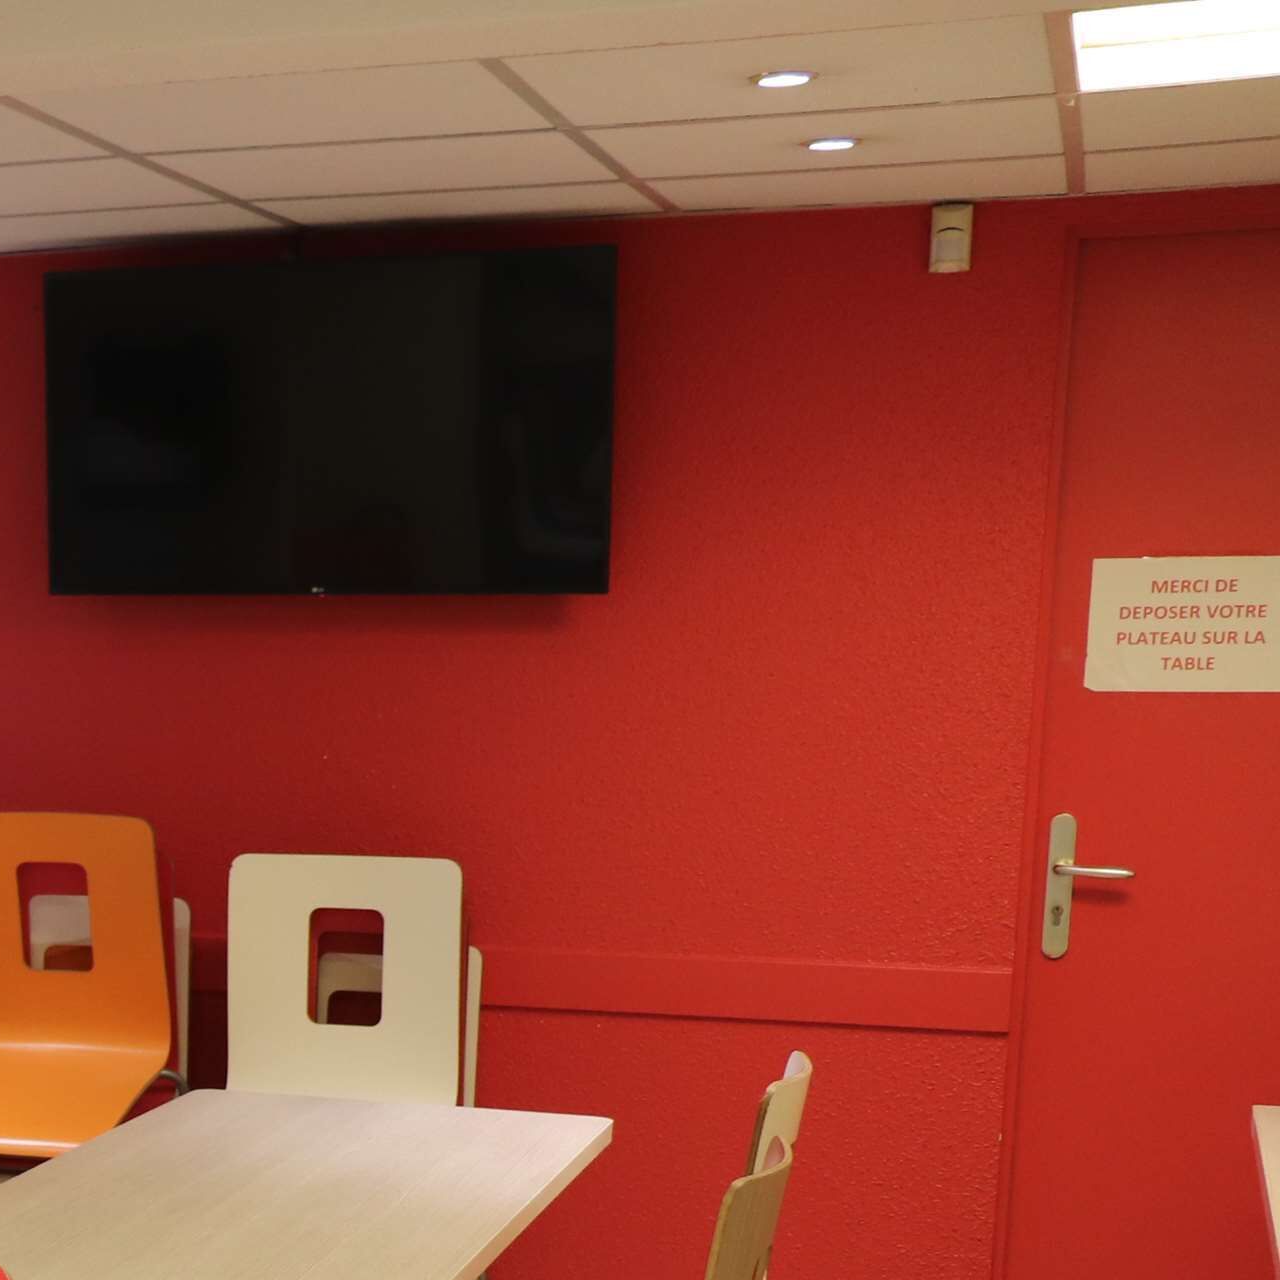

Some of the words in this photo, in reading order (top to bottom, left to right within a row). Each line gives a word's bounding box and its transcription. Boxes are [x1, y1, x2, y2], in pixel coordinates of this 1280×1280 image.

[1151, 580, 1209, 594] MERCI
[1215, 579, 1239, 593] DE
[1119, 605, 1201, 620] DEPOSER
[1206, 604, 1268, 619] VOTRE
[1116, 631, 1197, 646] PLATEAU
[1202, 631, 1239, 645] SUR
[1244, 630, 1266, 645] LA
[1161, 656, 1216, 671] TABLE
